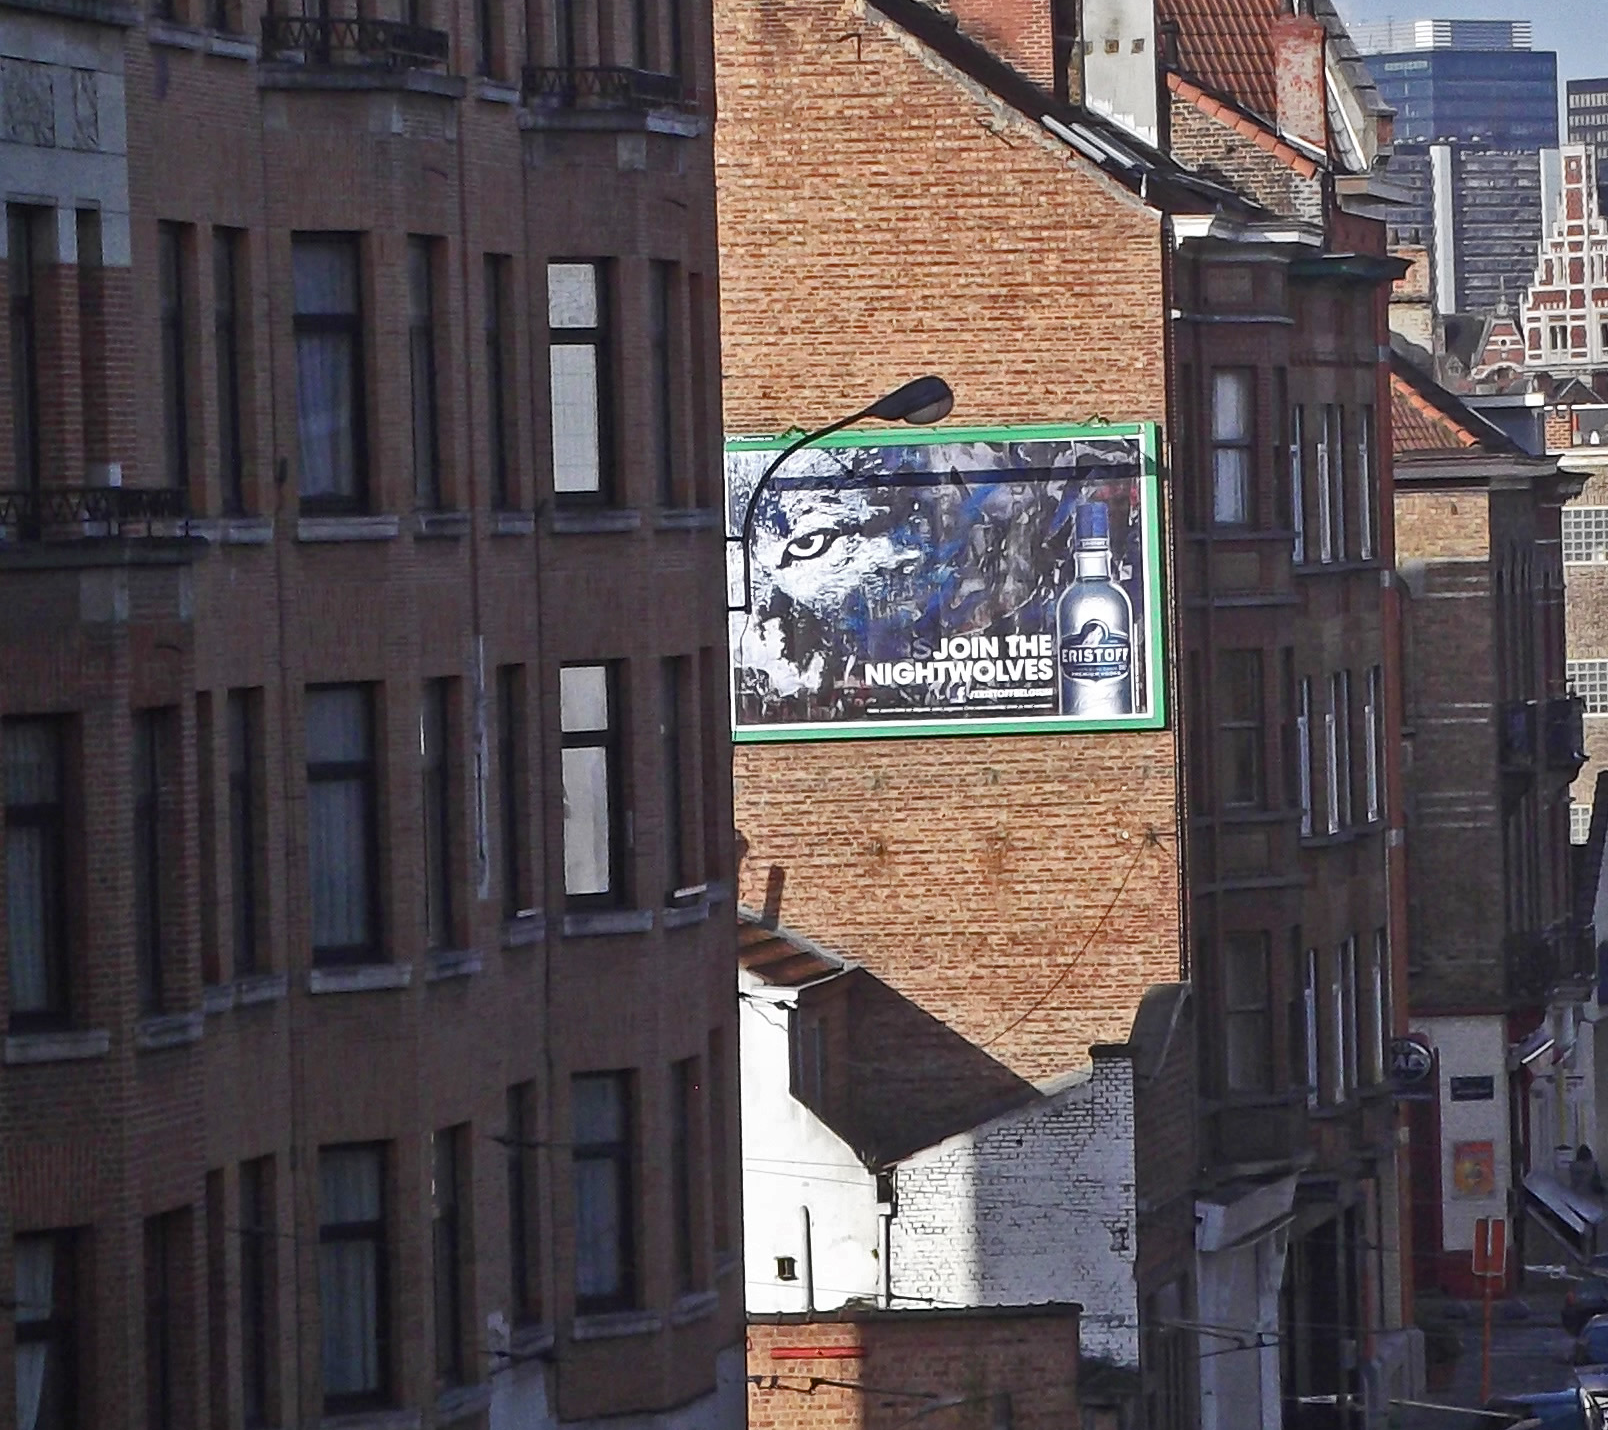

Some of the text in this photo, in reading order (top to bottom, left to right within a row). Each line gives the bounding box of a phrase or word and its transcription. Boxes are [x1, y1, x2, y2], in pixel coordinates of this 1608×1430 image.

[932, 635, 998, 660] JOIN
[1006, 634, 1053, 658] THE
[1061, 647, 1129, 663] ERISTOFF
[864, 658, 1054, 686] NIGHTWOLVES
